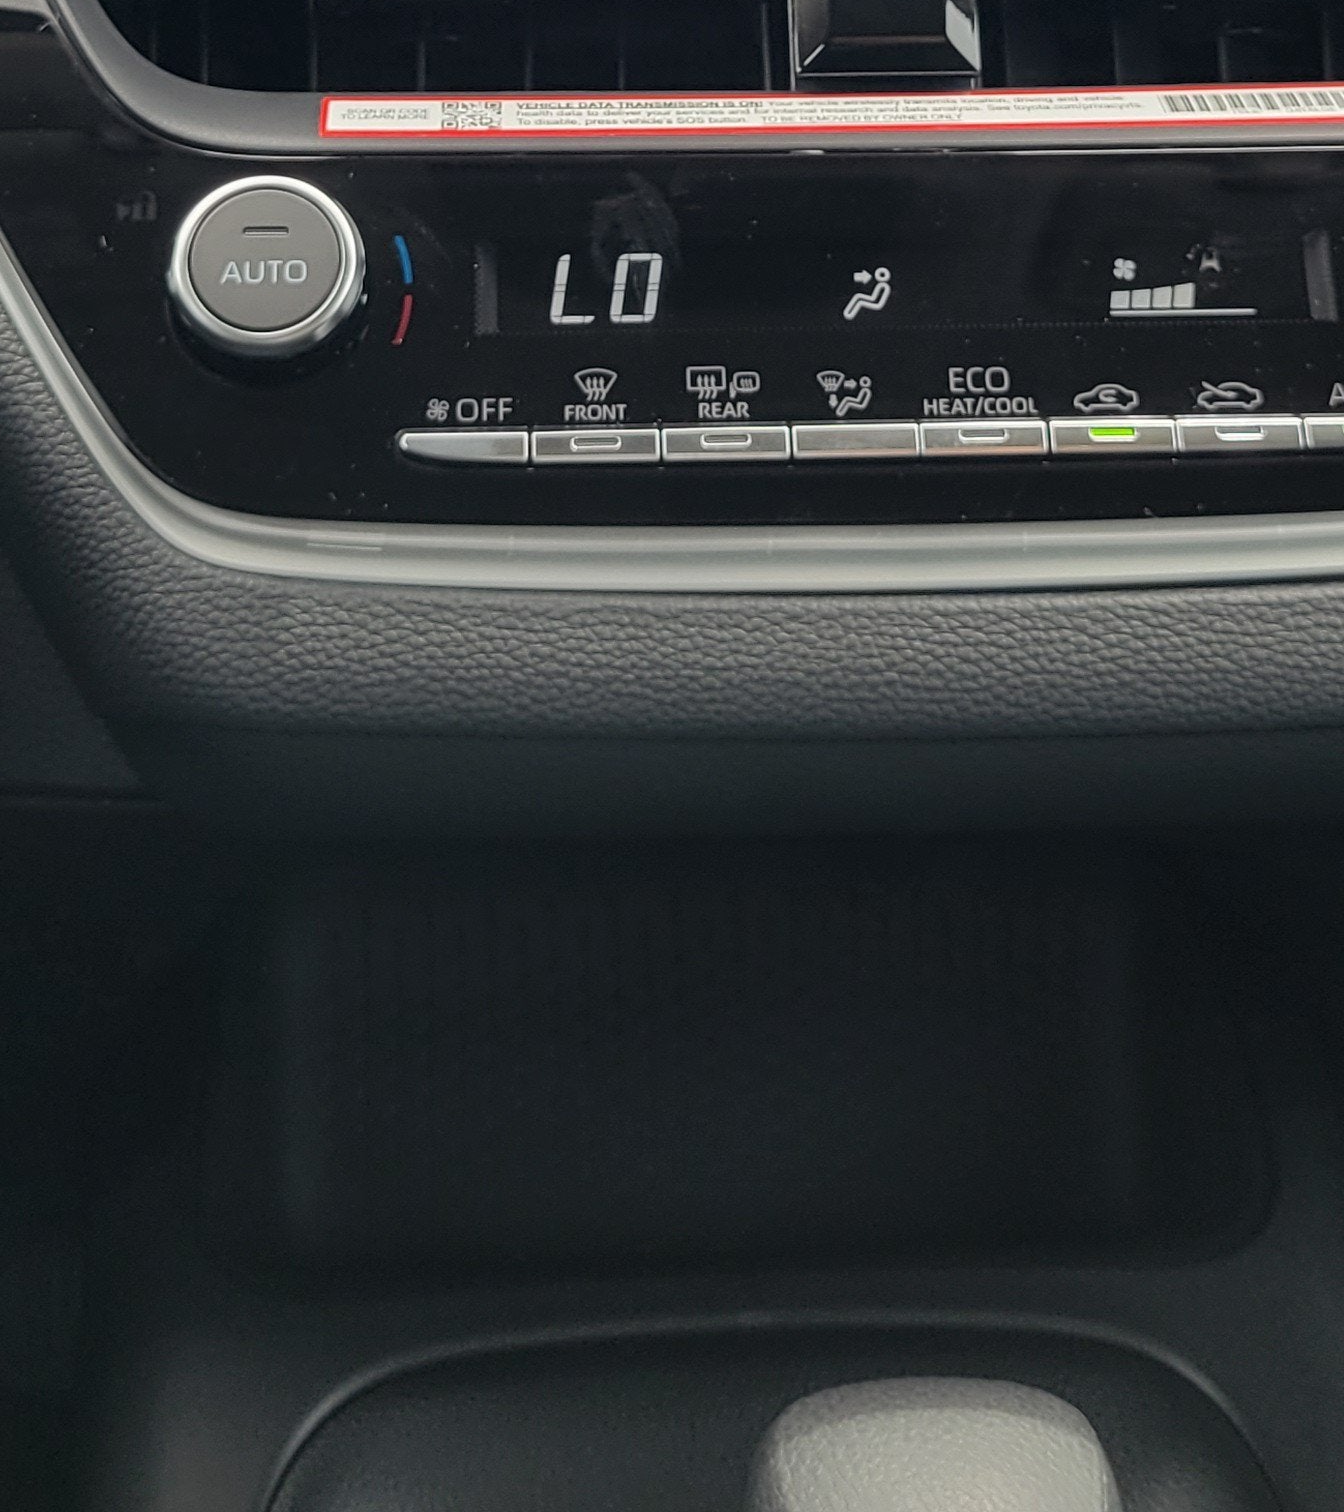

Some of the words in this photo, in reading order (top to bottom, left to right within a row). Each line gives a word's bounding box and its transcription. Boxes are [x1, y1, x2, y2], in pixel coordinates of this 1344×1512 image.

[517, 102, 573, 110] VEHICLE
[578, 102, 614, 110] DATA
[619, 101, 719, 109] TRANSMISSION
[220, 259, 307, 284] AUTO
[549, 252, 663, 325] LO
[947, 366, 1010, 395] ECO
[456, 396, 514, 422] OFF
[563, 402, 627, 422] FRONT
[698, 401, 750, 419] REAR
[923, 396, 1038, 417] HEAT/COOL
